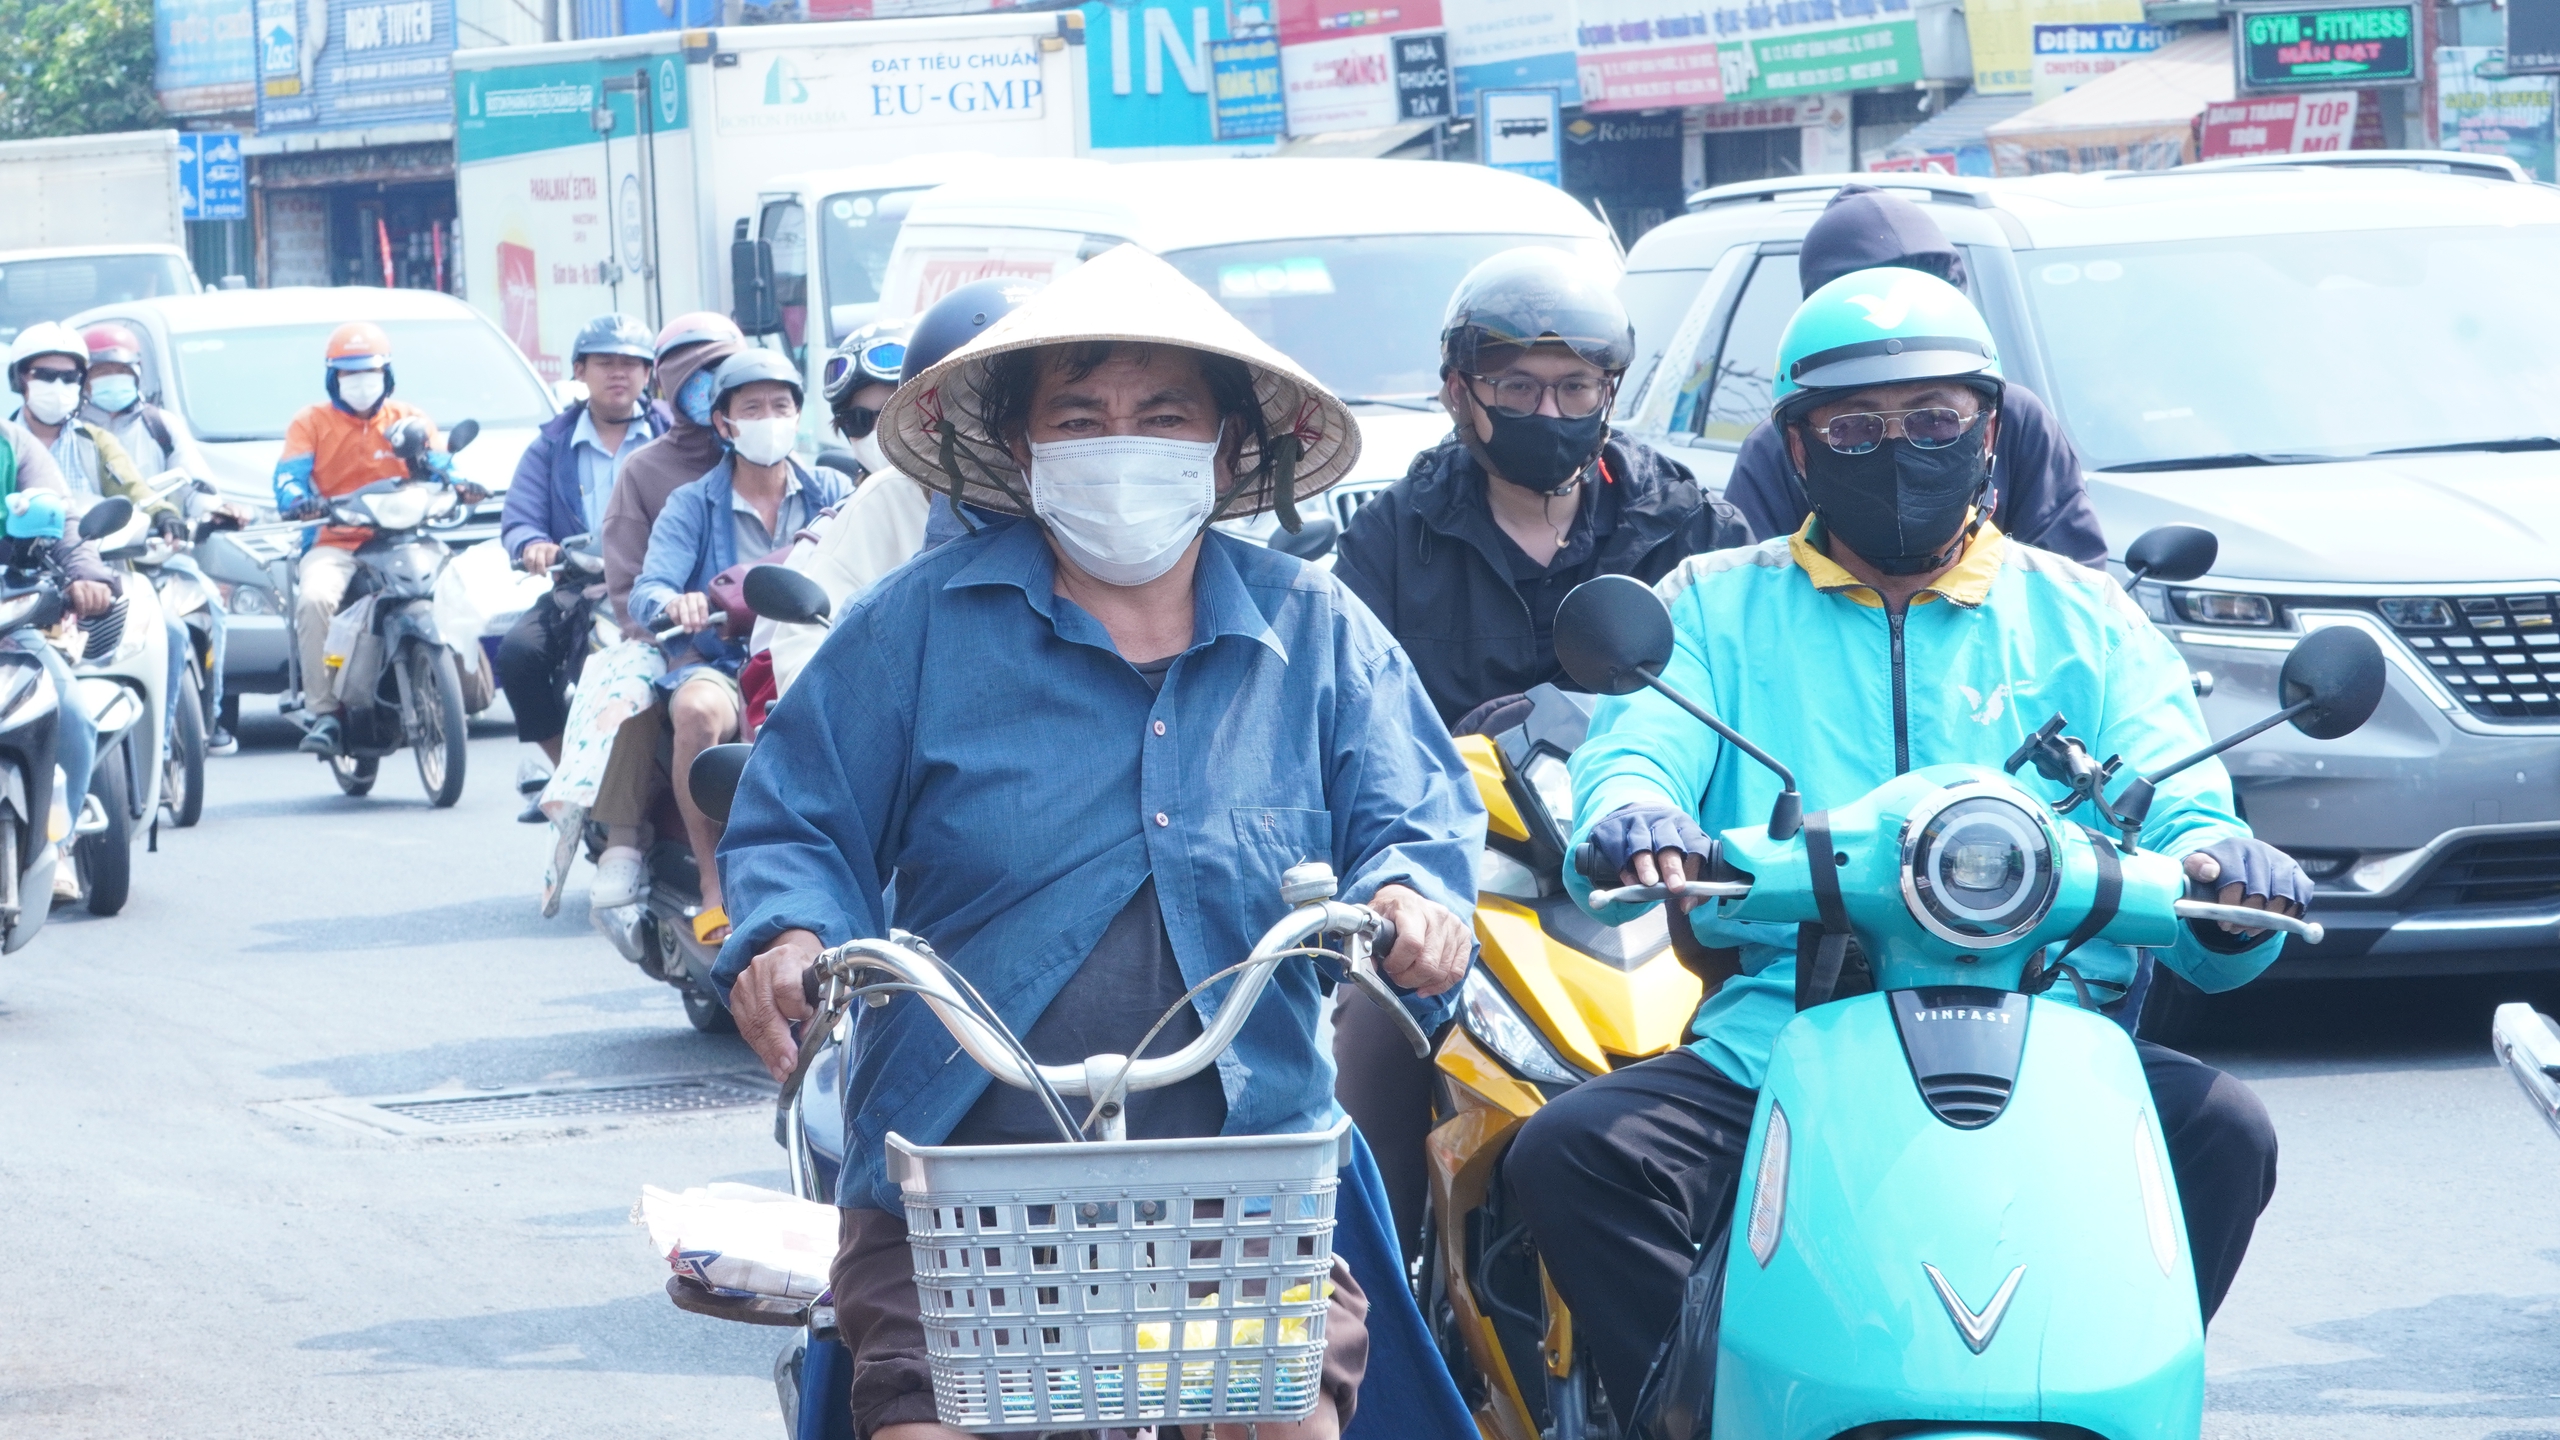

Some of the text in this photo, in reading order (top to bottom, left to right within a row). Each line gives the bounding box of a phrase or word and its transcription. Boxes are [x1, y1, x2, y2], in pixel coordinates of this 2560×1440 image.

[2250, 16, 2299, 45] GYM
[2315, 10, 2409, 42] FITNESS
[1109, 3, 1210, 97] IN
[1403, 38, 1438, 63] NHÀ
[2038, 28, 2098, 53] ĐIỆN
[871, 58, 911, 77] ĐẠT
[918, 52, 960, 71] TIÊU
[1398, 64, 1448, 90] THUỐC
[784, 109, 848, 126] PHARMA
[1409, 94, 1440, 116] TÂY
[1181, 469, 1199, 479] DCK
[1914, 1009, 2011, 1024] VINFAST
